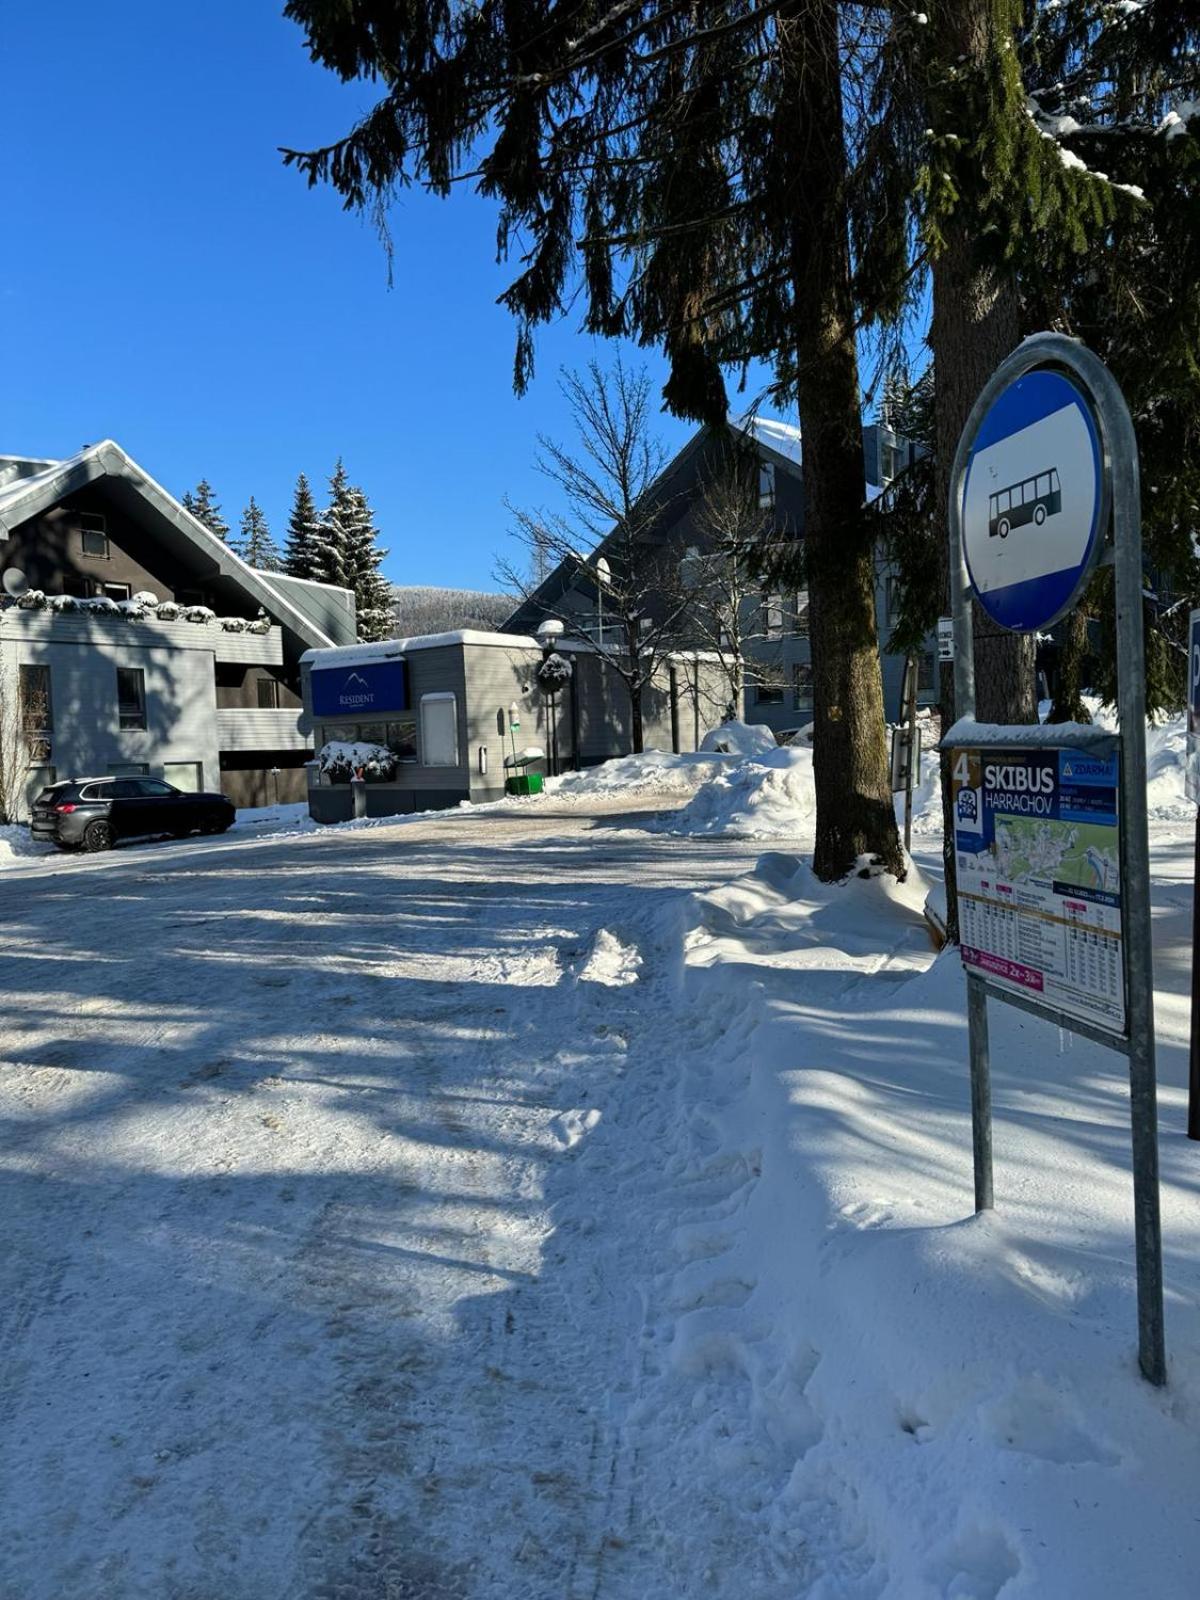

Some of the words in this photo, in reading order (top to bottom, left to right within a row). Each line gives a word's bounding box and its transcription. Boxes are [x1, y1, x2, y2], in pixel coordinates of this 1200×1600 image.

[339, 693, 374, 704] RESIDENT
[953, 752, 970, 787] 4
[985, 765, 1054, 794] SKIBUS
[985, 792, 1053, 814] HARRACHOV
